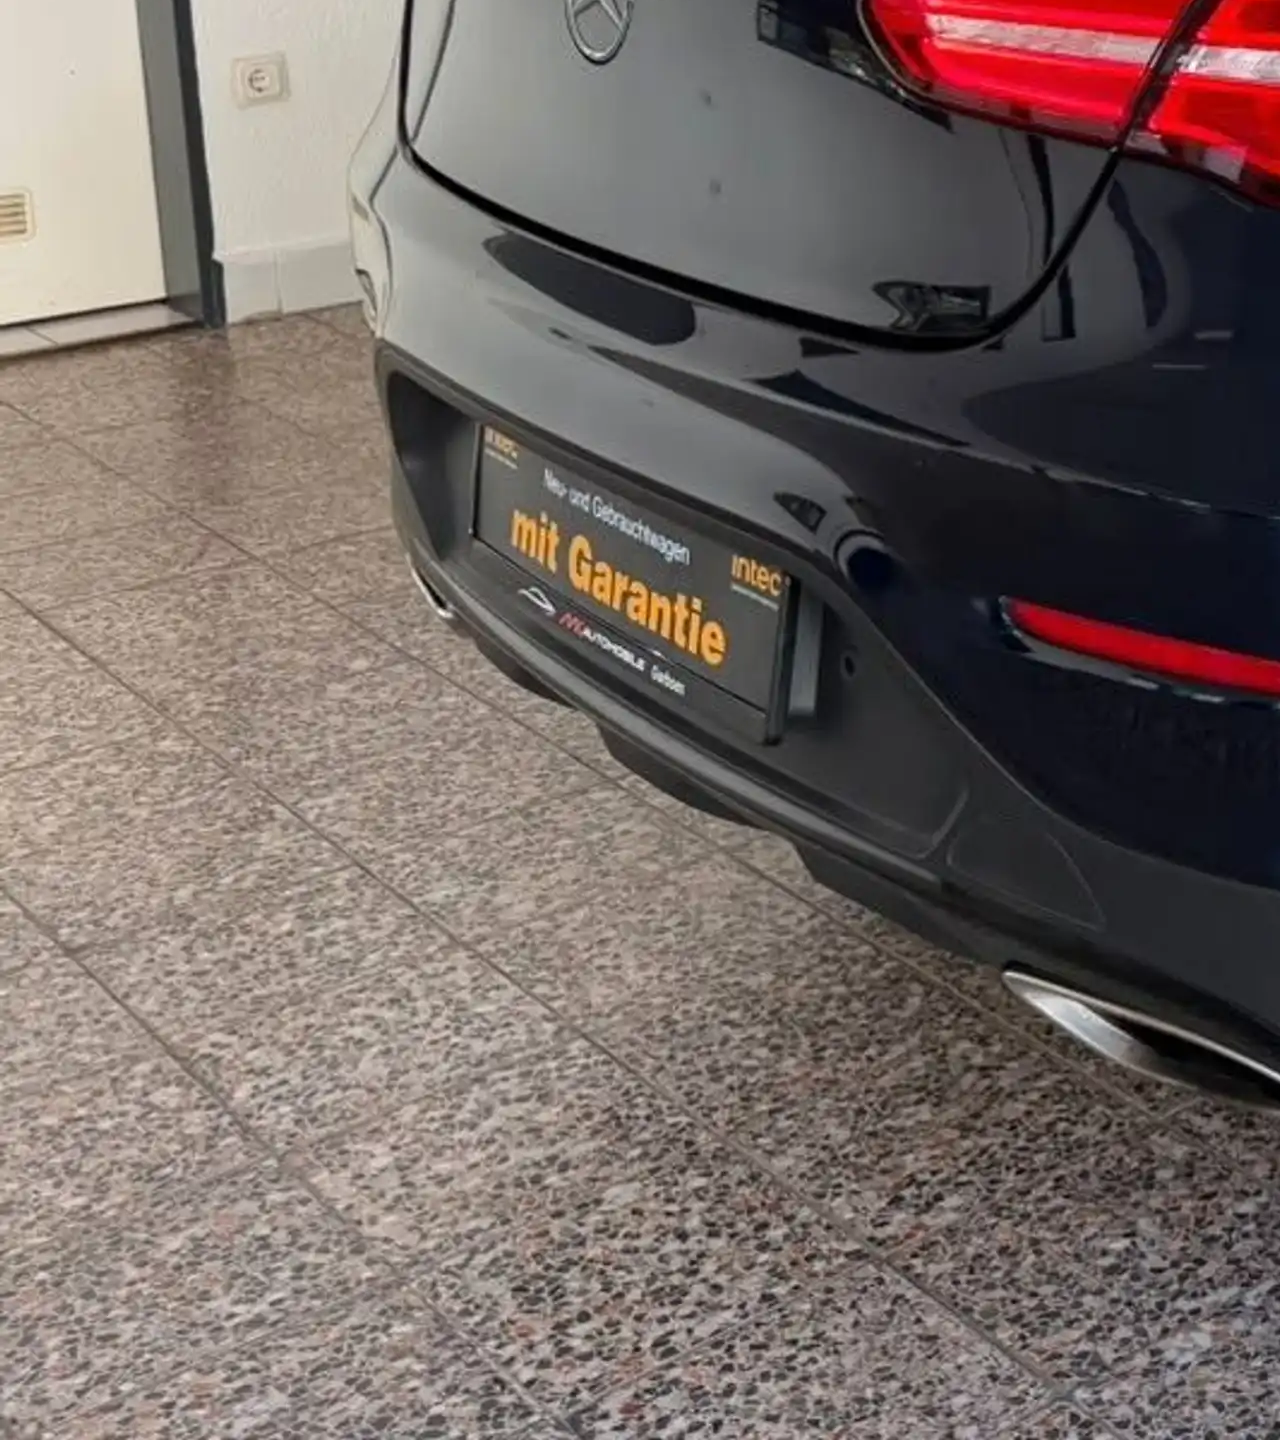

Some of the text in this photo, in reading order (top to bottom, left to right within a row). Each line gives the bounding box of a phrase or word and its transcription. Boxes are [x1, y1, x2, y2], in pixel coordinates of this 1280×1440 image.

[569, 487, 590, 513] und
[592, 496, 691, 565] Gebrauchtwagen
[511, 509, 728, 666] mit Garantie
